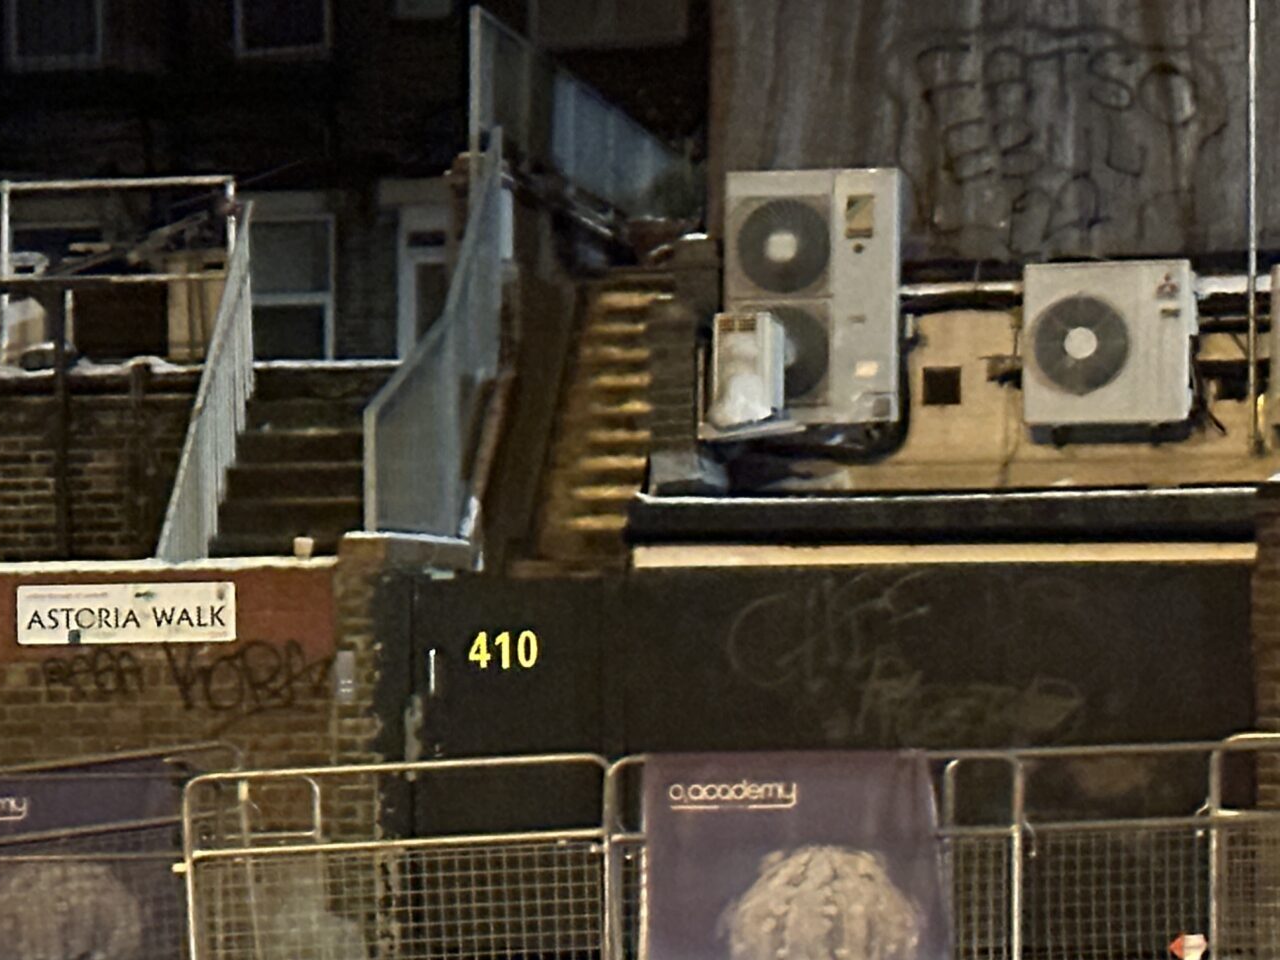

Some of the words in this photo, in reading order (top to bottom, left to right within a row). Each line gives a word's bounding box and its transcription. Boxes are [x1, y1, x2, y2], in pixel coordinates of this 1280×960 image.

[26, 607, 142, 631] ASTORIA
[152, 605, 227, 629] WALK
[468, 629, 538, 670] 410
